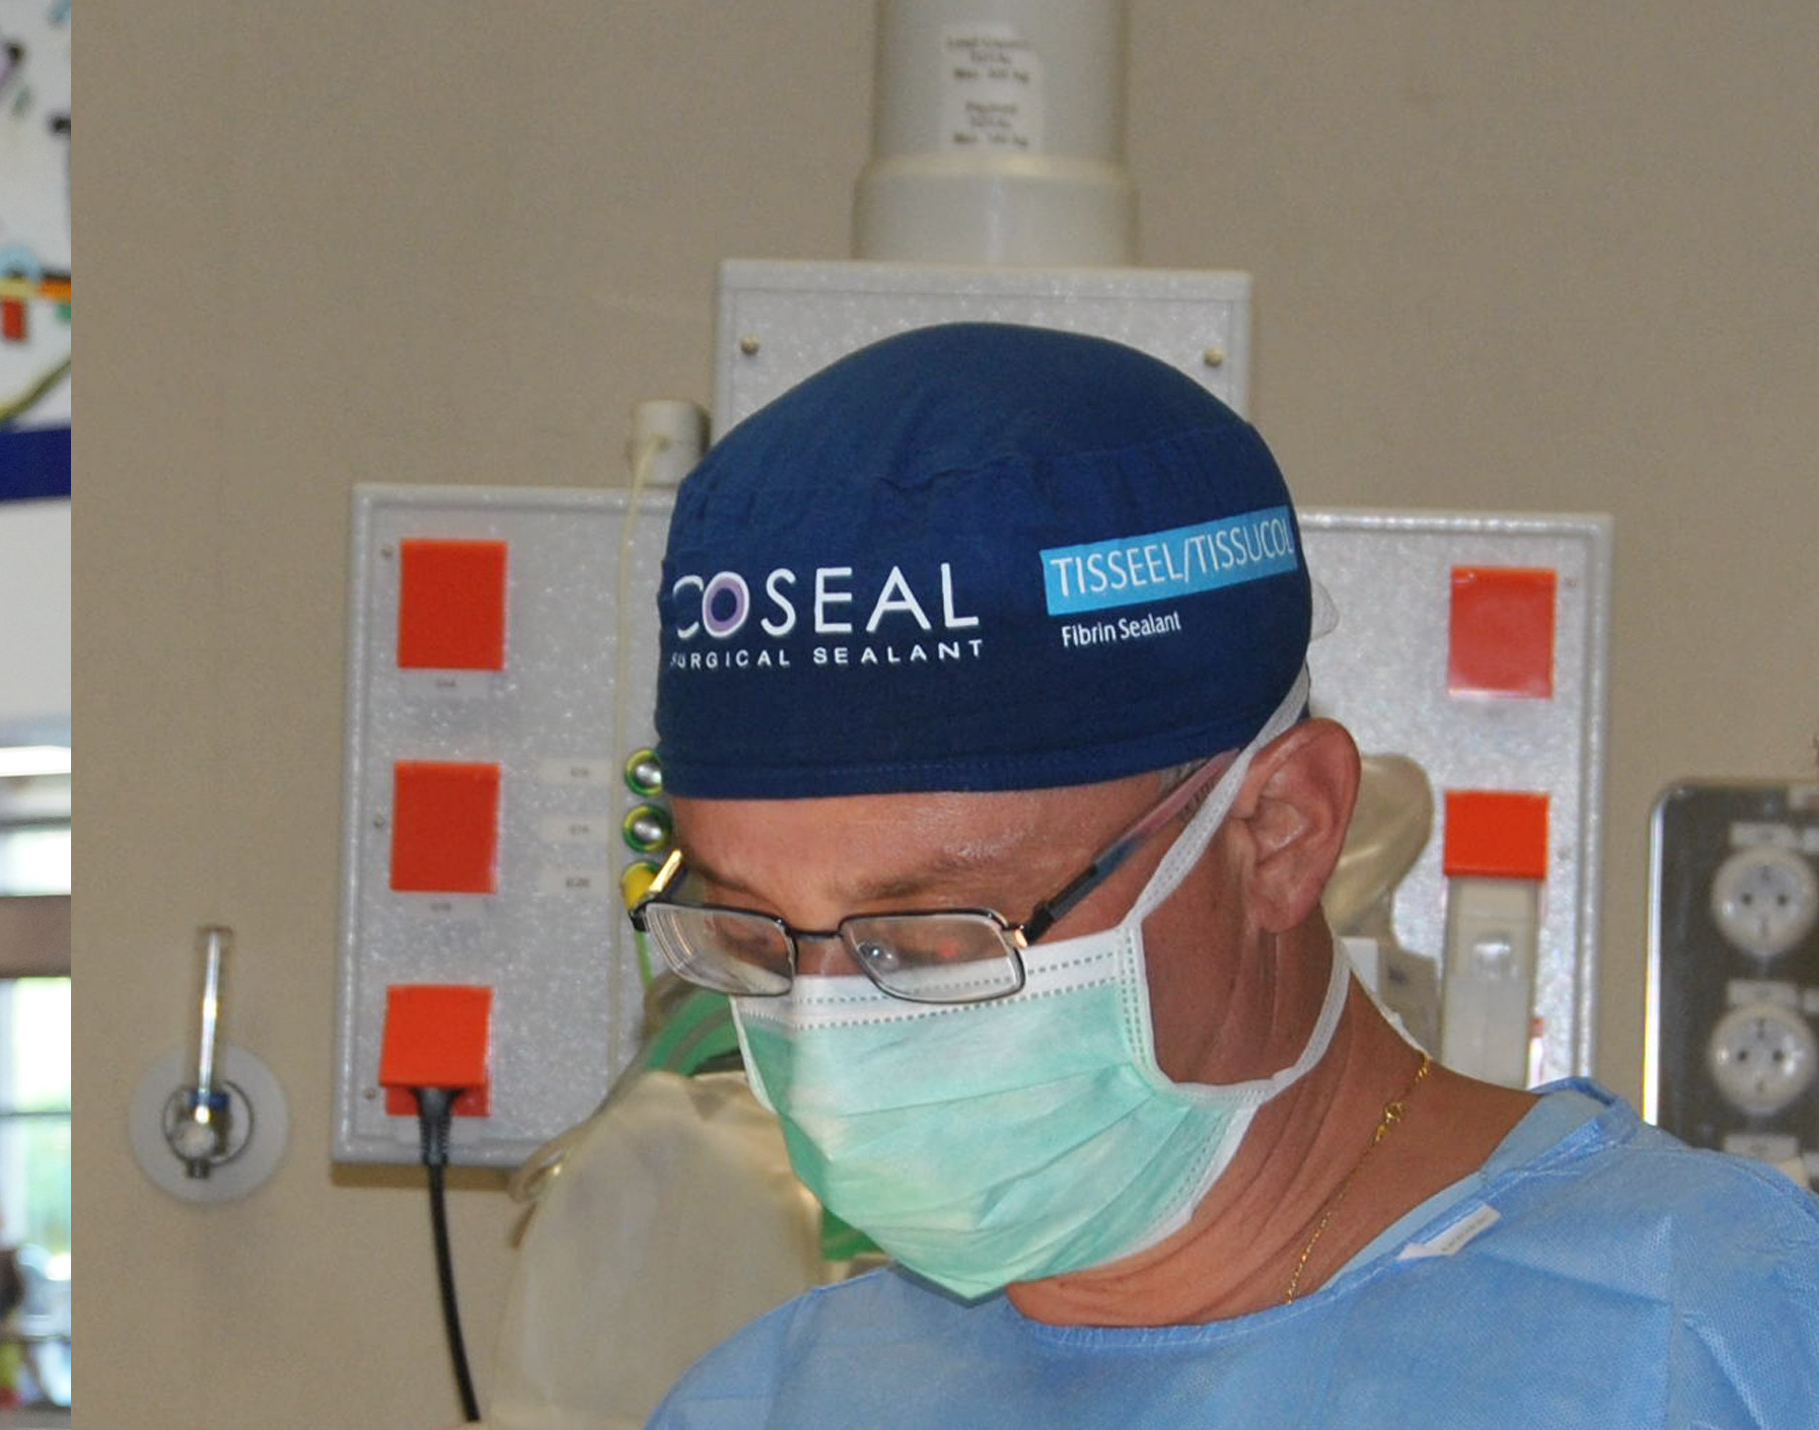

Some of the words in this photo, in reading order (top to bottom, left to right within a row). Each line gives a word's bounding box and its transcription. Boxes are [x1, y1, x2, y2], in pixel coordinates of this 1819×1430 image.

[1050, 518, 1295, 597] TISSEEL/TISSUCOL
[1062, 619, 1117, 648] Fibrin
[1118, 611, 1182, 640] Sealant
[813, 639, 983, 664] SEALANT
